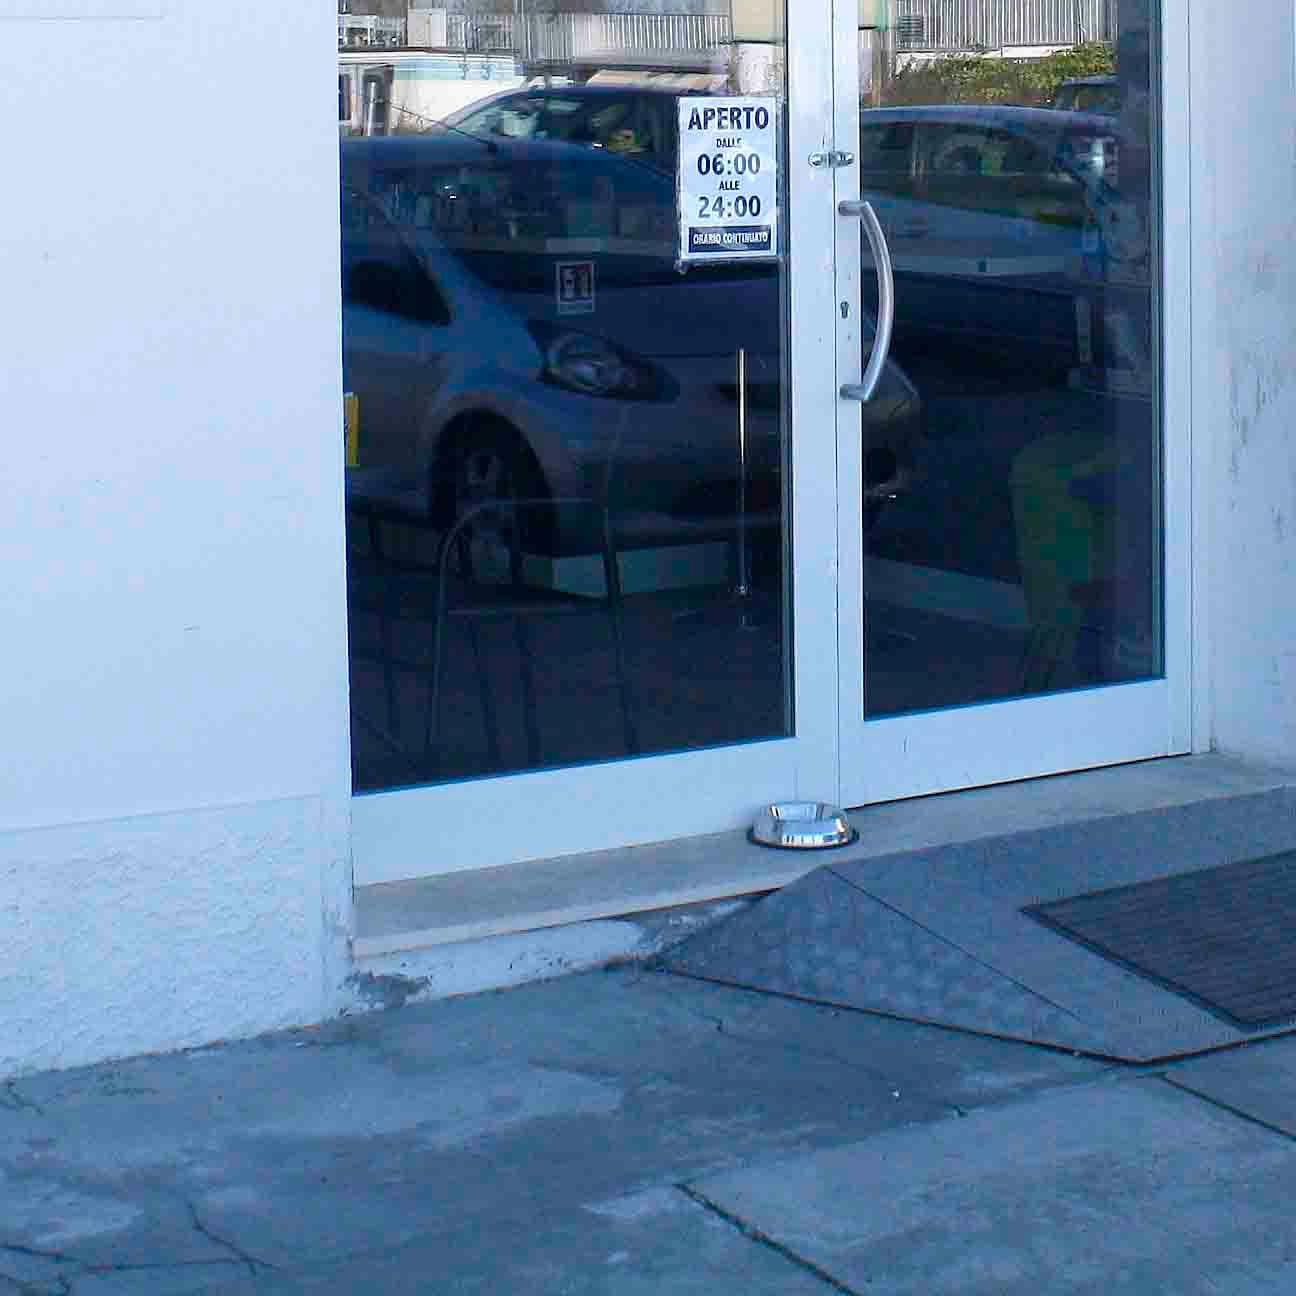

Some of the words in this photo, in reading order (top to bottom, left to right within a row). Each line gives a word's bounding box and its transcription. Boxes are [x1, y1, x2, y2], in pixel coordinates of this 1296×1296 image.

[688, 106, 769, 130] APERTO
[697, 153, 761, 175] 06:00
[719, 180, 740, 191] ALLE
[698, 195, 761, 218] 24:00
